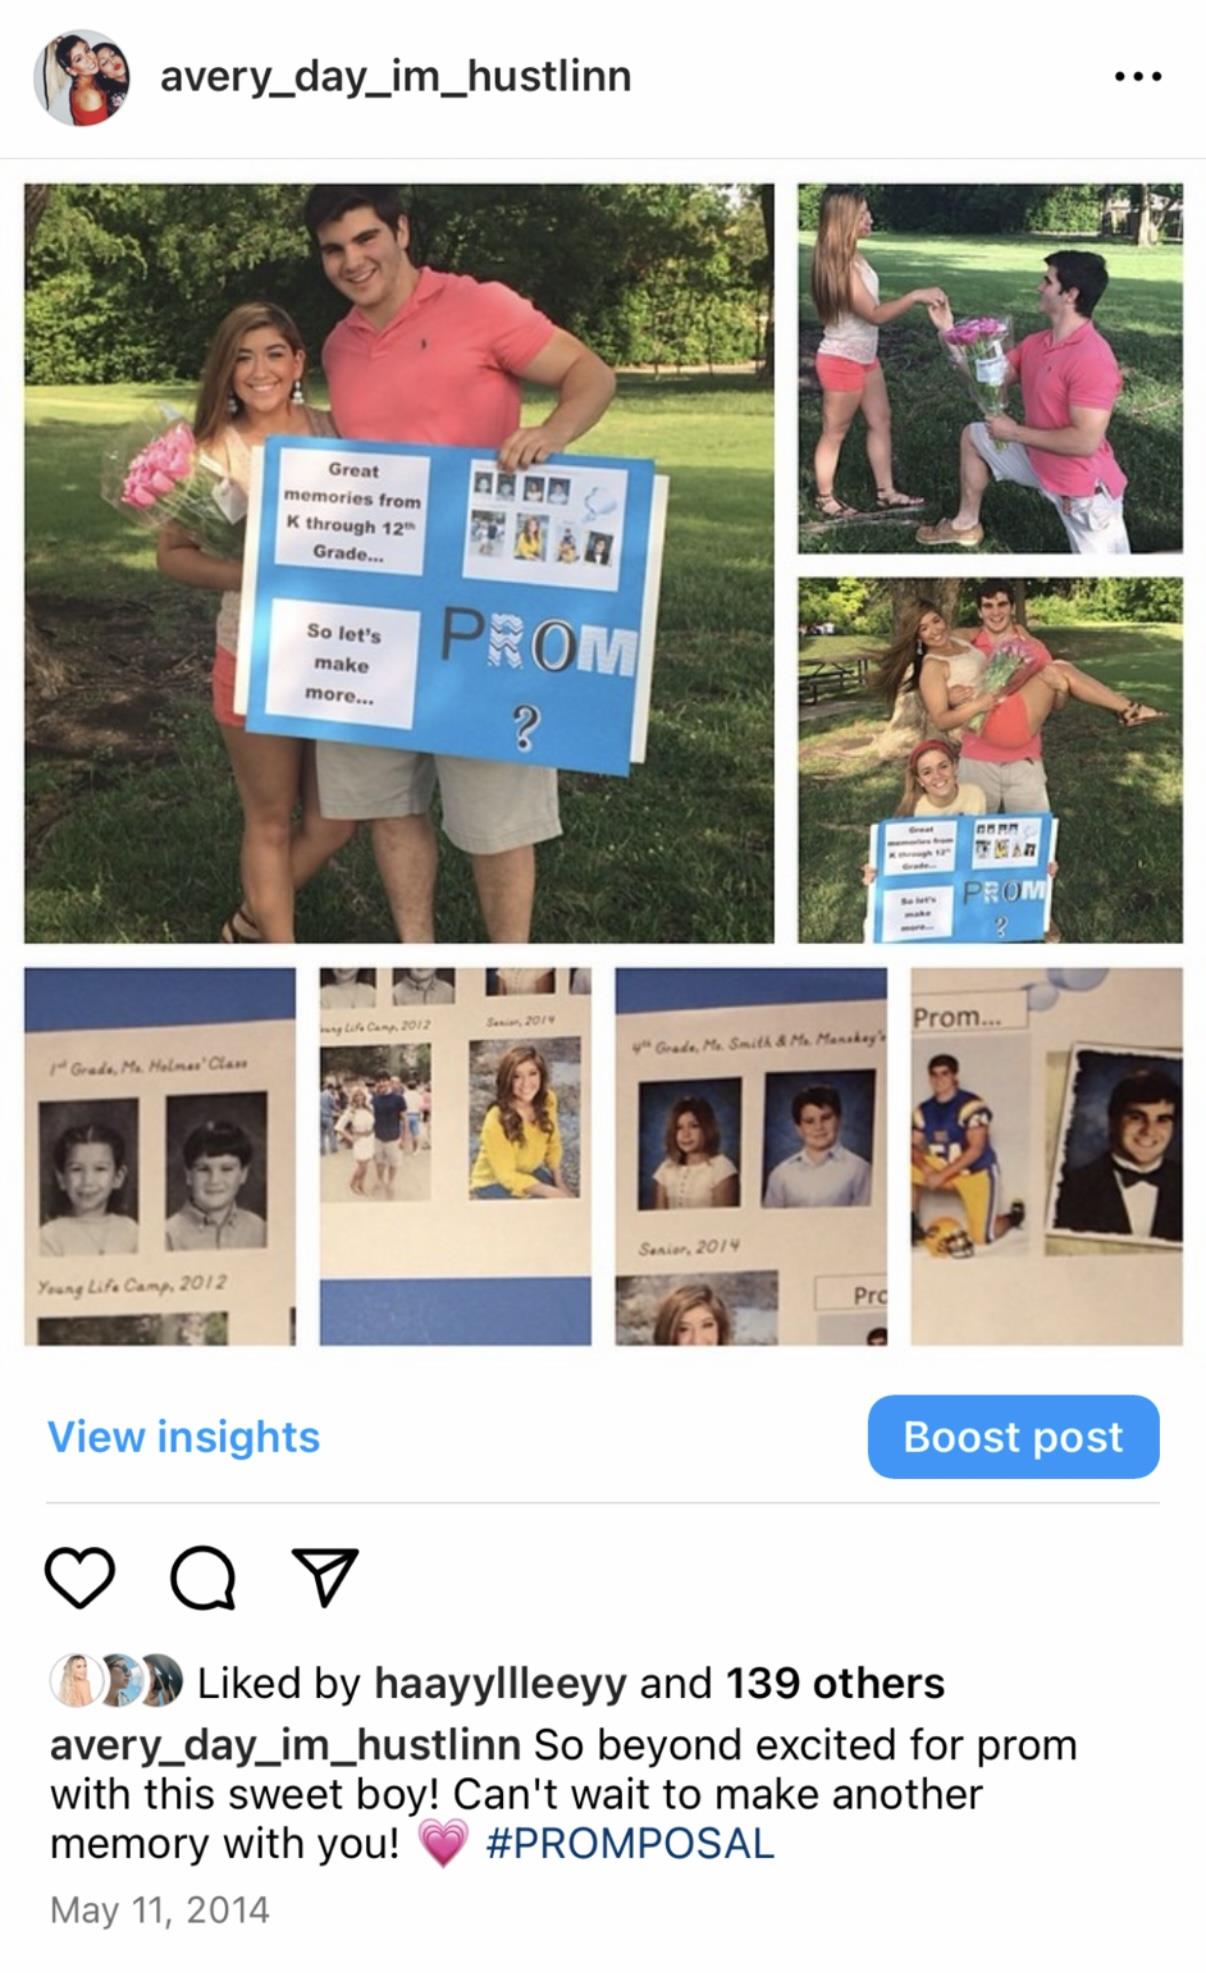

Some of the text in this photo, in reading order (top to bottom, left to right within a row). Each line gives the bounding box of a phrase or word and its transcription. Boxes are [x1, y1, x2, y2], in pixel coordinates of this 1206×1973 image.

[160, 56, 631, 100] avery_day_im_hustlinn
[329, 462, 380, 478] Great
[284, 490, 422, 509] memories from
[286, 514, 416, 536] K through 12th
[313, 544, 384, 562] Grade...
[307, 623, 382, 644] So let's
[441, 606, 638, 678] PROM
[314, 657, 370, 674] make
[305, 687, 374, 705] more...
[513, 703, 541, 753] ?
[909, 826, 934, 834] Great
[887, 836, 954, 847] memories from
[889, 852, 897, 860] K
[898, 850, 933, 860] through
[901, 897, 913, 906] So
[963, 880, 1046, 905] PROM
[904, 910, 931, 919] make
[994, 915, 1009, 938] ?
[345, 1022, 365, 1033] Life
[402, 1019, 432, 1031] 2012
[525, 1015, 555, 1026] 2014
[913, 1007, 1002, 1028] Prom...
[729, 1034, 772, 1050] Smith
[775, 1034, 787, 1048] &
[208, 1055, 248, 1071] Class
[638, 1239, 741, 1257] Senior, 2014
[38, 1274, 228, 1300] Young Life Camp, 2012
[47, 1417, 321, 1461] View insights
[904, 1420, 1124, 1461] Boost post
[199, 1665, 946, 1708] Liked by haayyllleeyy and 139 others
[50, 1726, 1077, 1769] avery_day_im_hustlinn So beyond excited for prom
[50, 1775, 984, 1818] with this sweet boy! Can't wait to make another
[51, 1825, 776, 1867] memory with you! #PROMPOSAL
[51, 1895, 270, 1930] May 11, 2014
